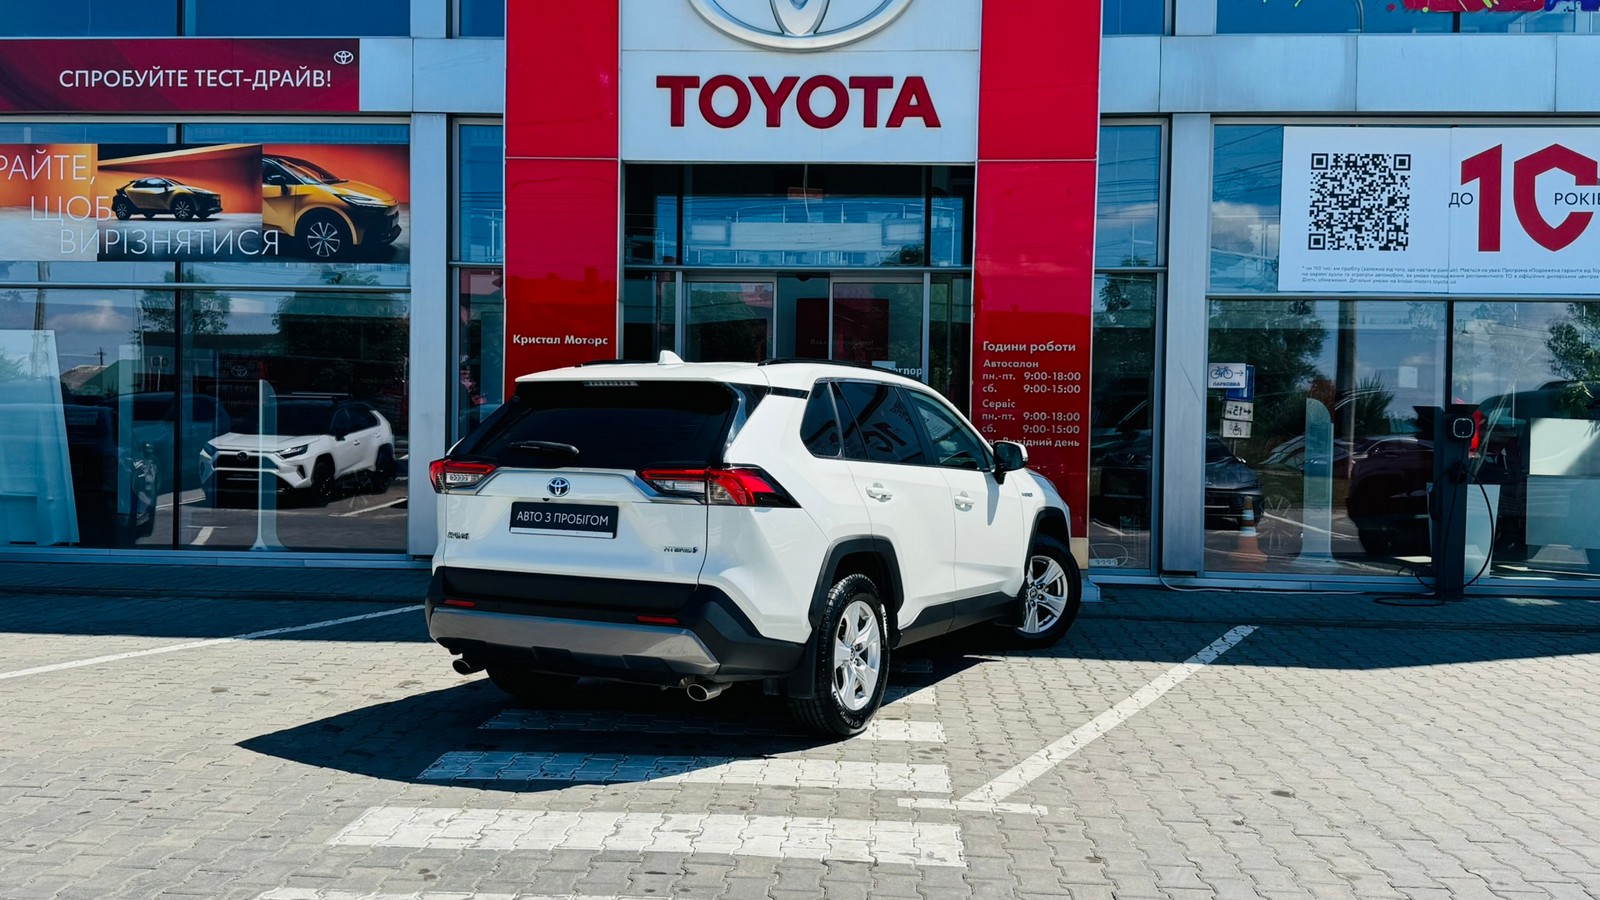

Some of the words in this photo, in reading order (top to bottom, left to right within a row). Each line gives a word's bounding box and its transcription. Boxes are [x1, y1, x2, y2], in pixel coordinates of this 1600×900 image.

[59, 65, 188, 88] СПРОБУЙТЕ
[194, 65, 332, 90] ТЕСТ-ДРАЙВ!
[656, 74, 942, 129] TOYOTA
[1448, 192, 1474, 208] ДО
[1460, 143, 1598, 252] 10
[30, 195, 113, 226] ЩОБ
[60, 229, 279, 256] ВИРІЗНЯТИСЯ
[512, 334, 560, 346] Кристал
[565, 335, 608, 346] Моторс
[982, 341, 1026, 352] Години
[1030, 341, 1076, 353] роботи
[983, 359, 1039, 368] Автосалон
[1024, 372, 1081, 380] 9:00-18:00
[982, 384, 997, 392] сб.
[1023, 384, 1081, 393] 9:00-15:00
[982, 399, 1016, 409] Сервіс
[1023, 412, 1080, 421] 9:00-18:00
[982, 424, 996, 433] сб.
[1023, 425, 1080, 434] 9:00-15:00
[1054, 439, 1080, 447] день
[516, 511, 543, 522] АВТО
[554, 513, 608, 526] ПРОБІГОМ
